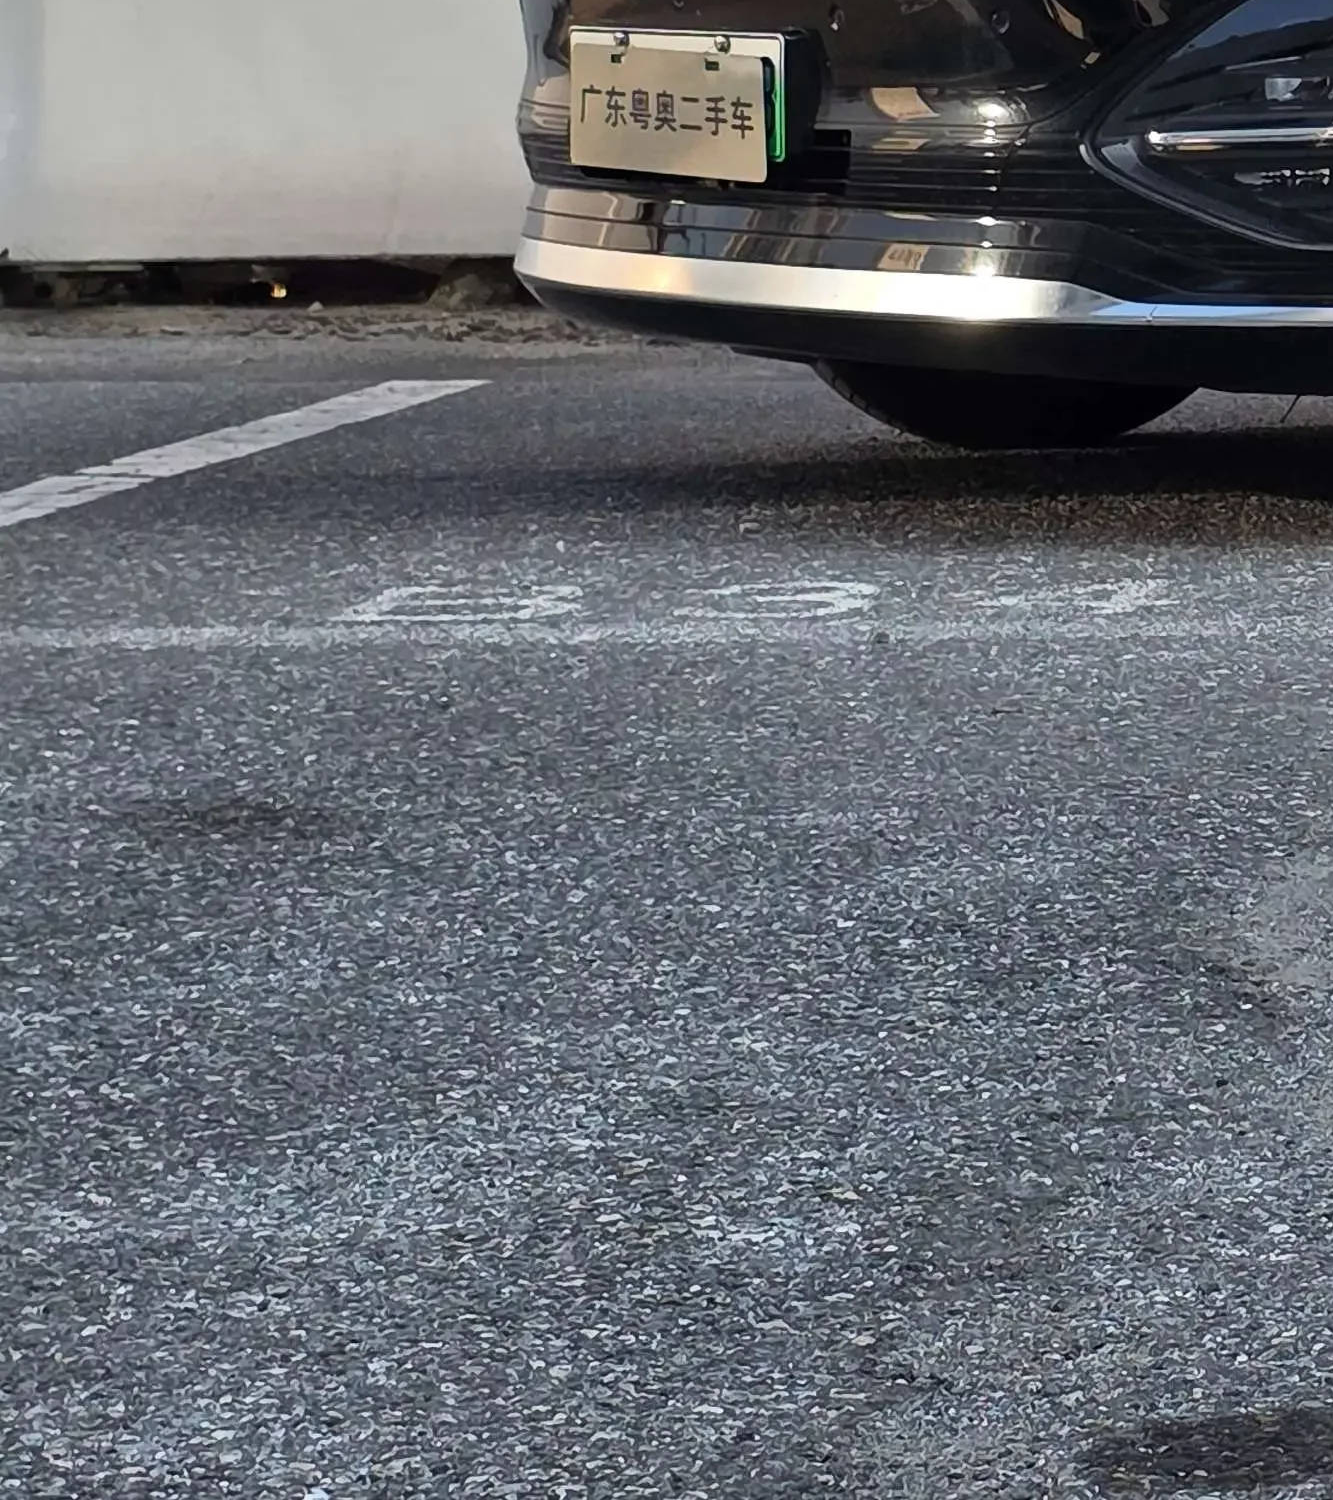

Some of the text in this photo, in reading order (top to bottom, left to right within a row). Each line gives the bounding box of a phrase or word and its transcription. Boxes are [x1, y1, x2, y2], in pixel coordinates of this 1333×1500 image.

[580, 84, 754, 139] 广东粤奥二手车
